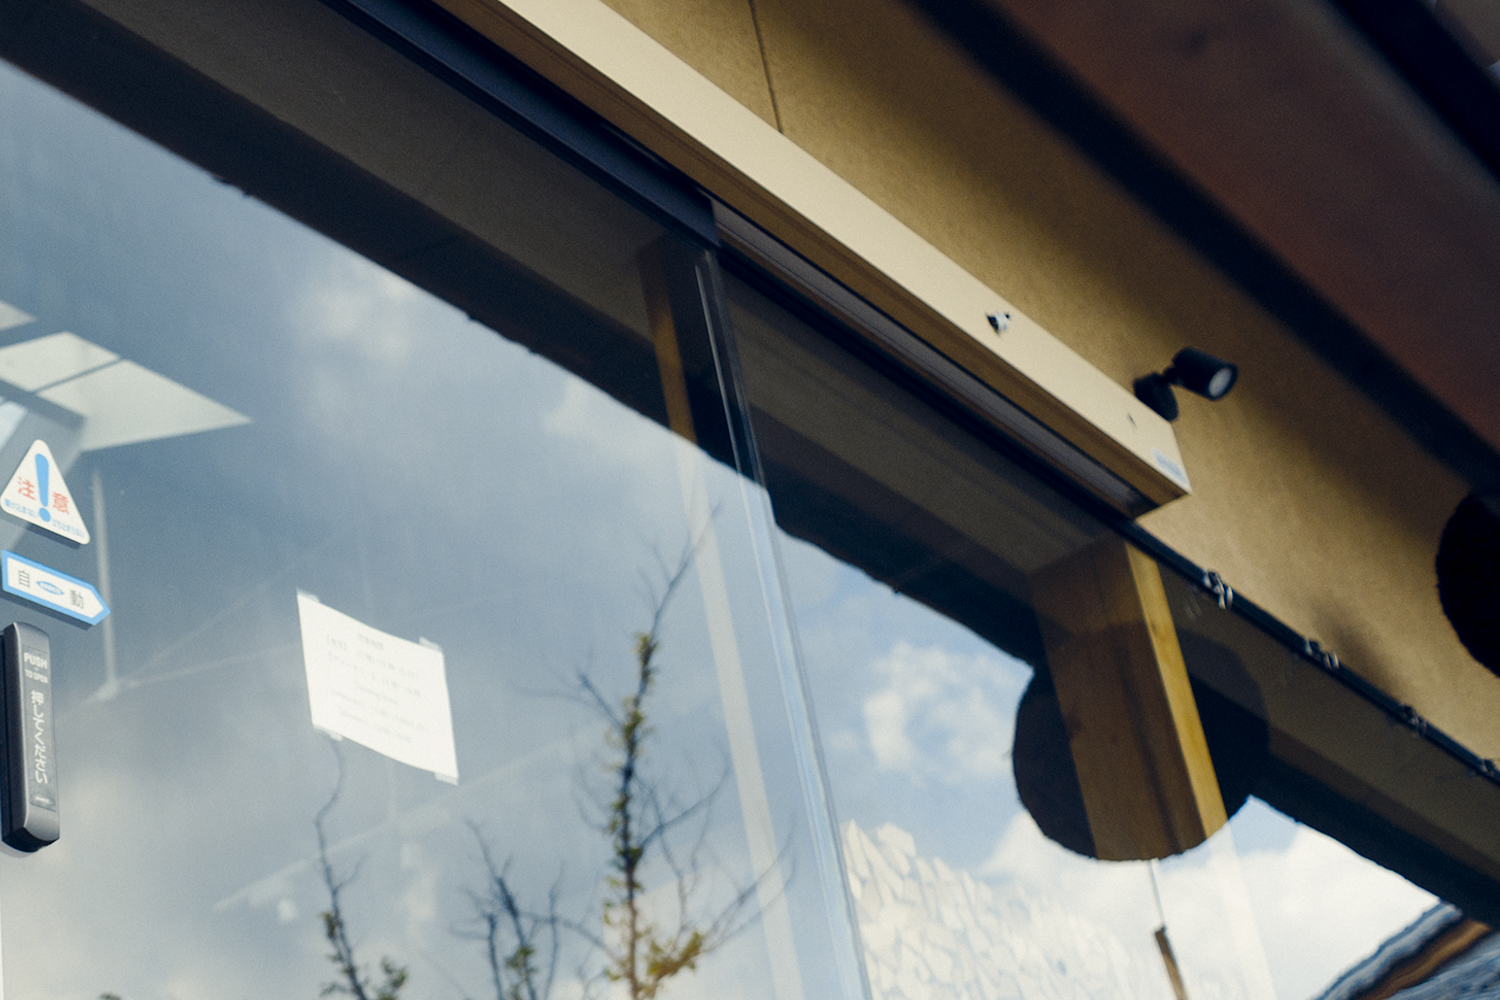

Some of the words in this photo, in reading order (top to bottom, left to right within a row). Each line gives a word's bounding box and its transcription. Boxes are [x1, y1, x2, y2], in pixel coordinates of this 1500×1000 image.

[17, 475, 36, 500] 注
[52, 491, 70, 515] 意
[18, 569, 30, 588] 自
[70, 589, 84, 609] 動
[23, 652, 48, 670] PUSH
[31, 689, 48, 785] 押してください
